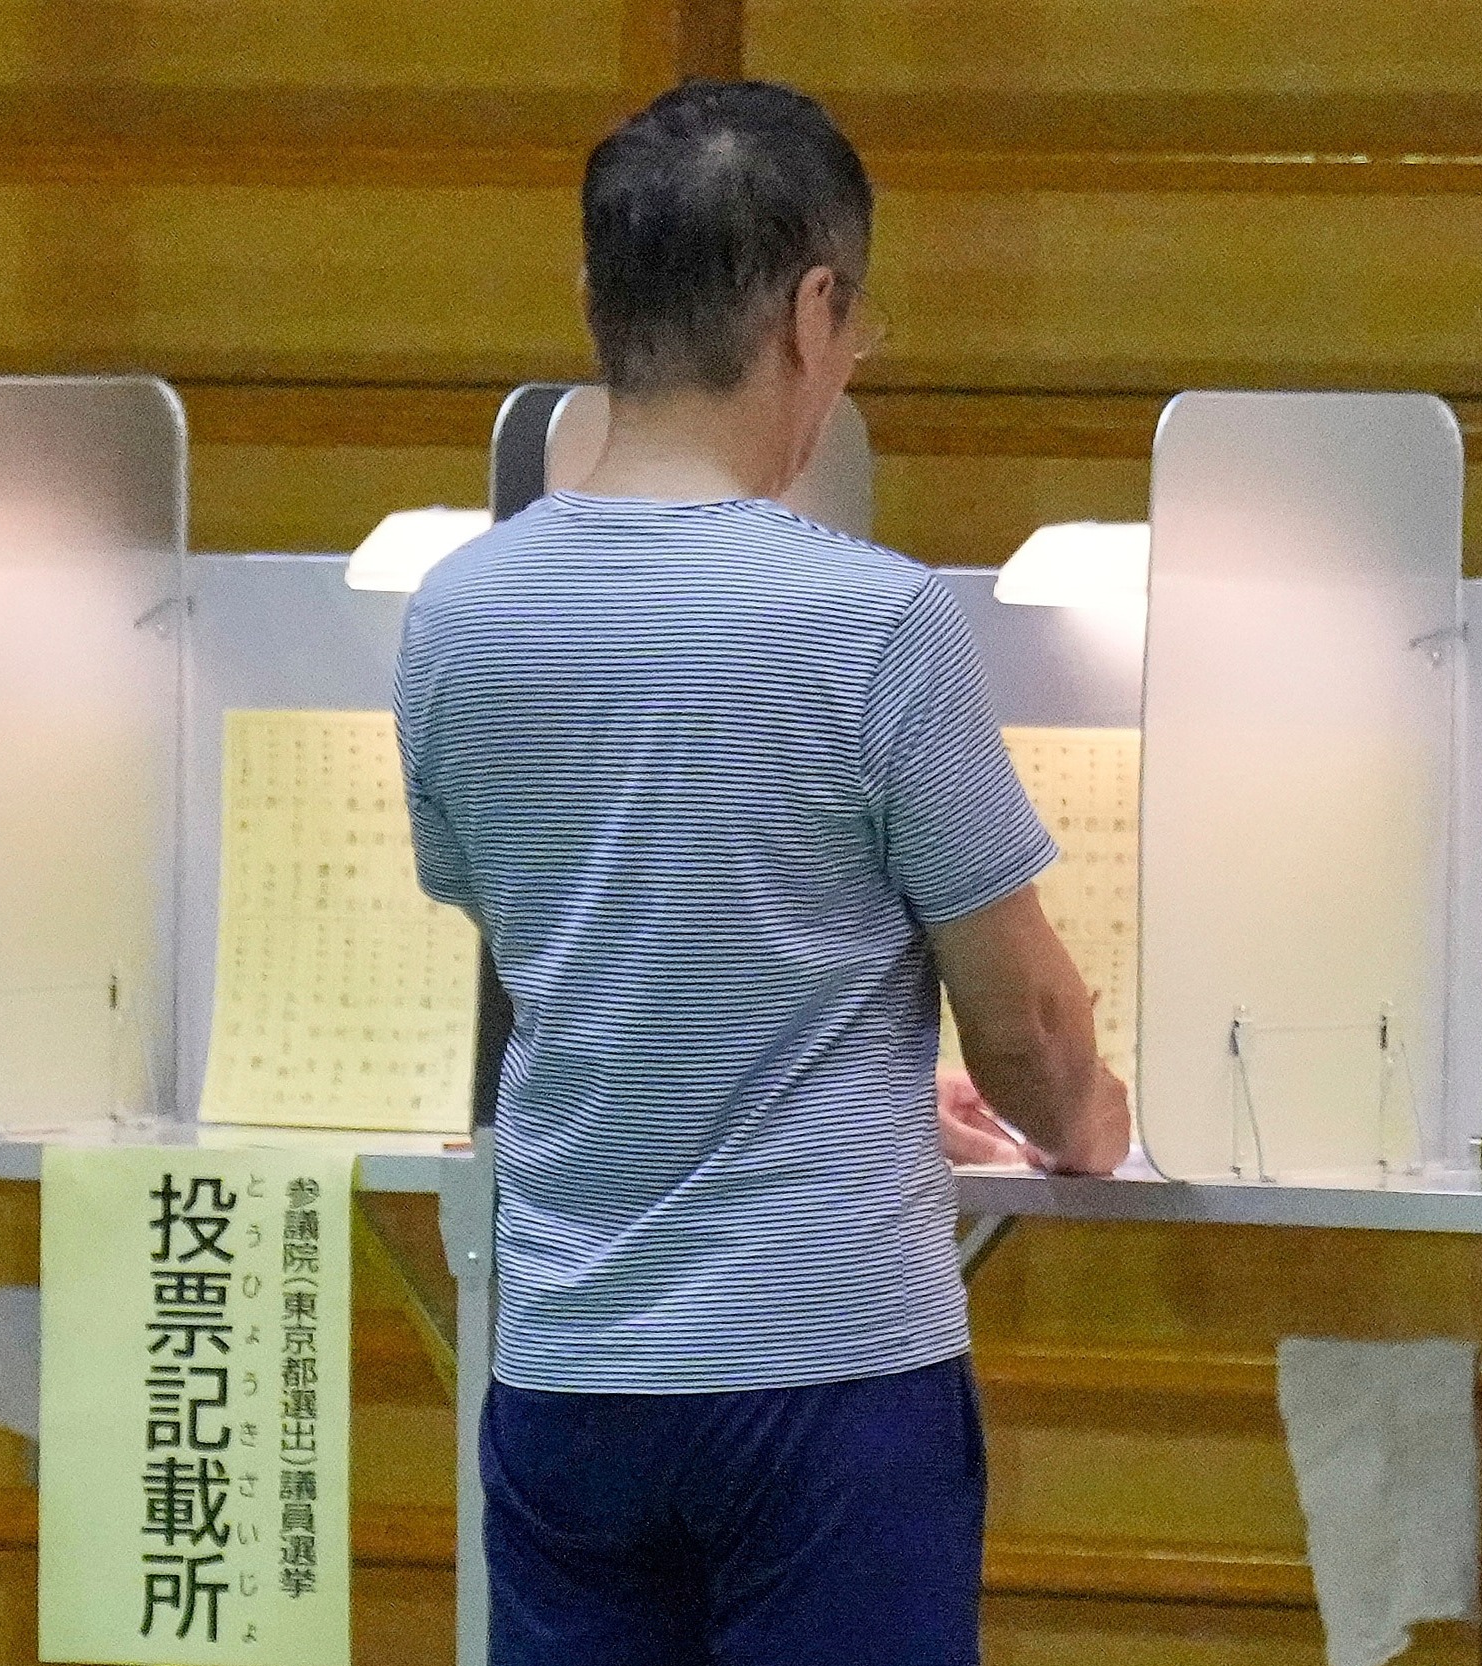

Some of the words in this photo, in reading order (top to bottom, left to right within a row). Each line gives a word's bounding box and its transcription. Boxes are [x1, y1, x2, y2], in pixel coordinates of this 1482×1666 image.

[139, 1172, 238, 1643] 投票記載所
[237, 1173, 265, 1644] とうひょうきさいじょ
